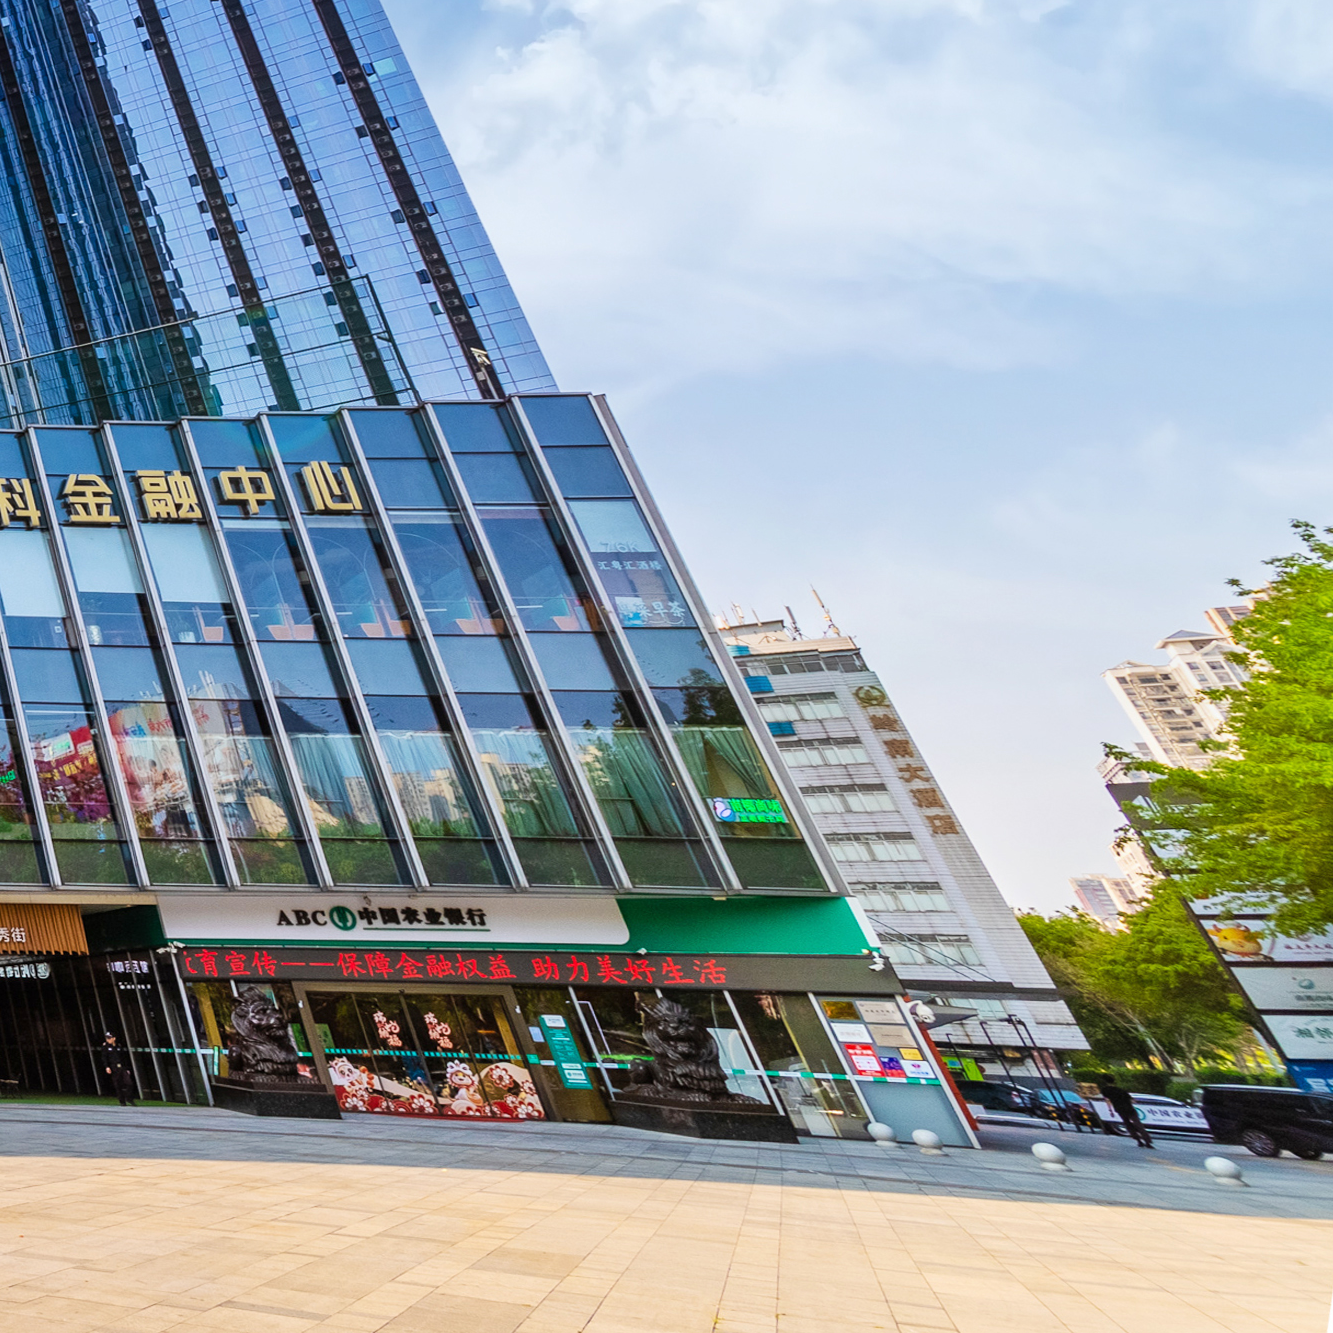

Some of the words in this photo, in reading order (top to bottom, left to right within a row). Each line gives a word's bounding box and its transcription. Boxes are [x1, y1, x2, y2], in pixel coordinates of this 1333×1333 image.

[277, 909, 329, 927] ABC
[358, 907, 487, 928] 中国农业银行
[532, 955, 728, 985] 助力美好生活
